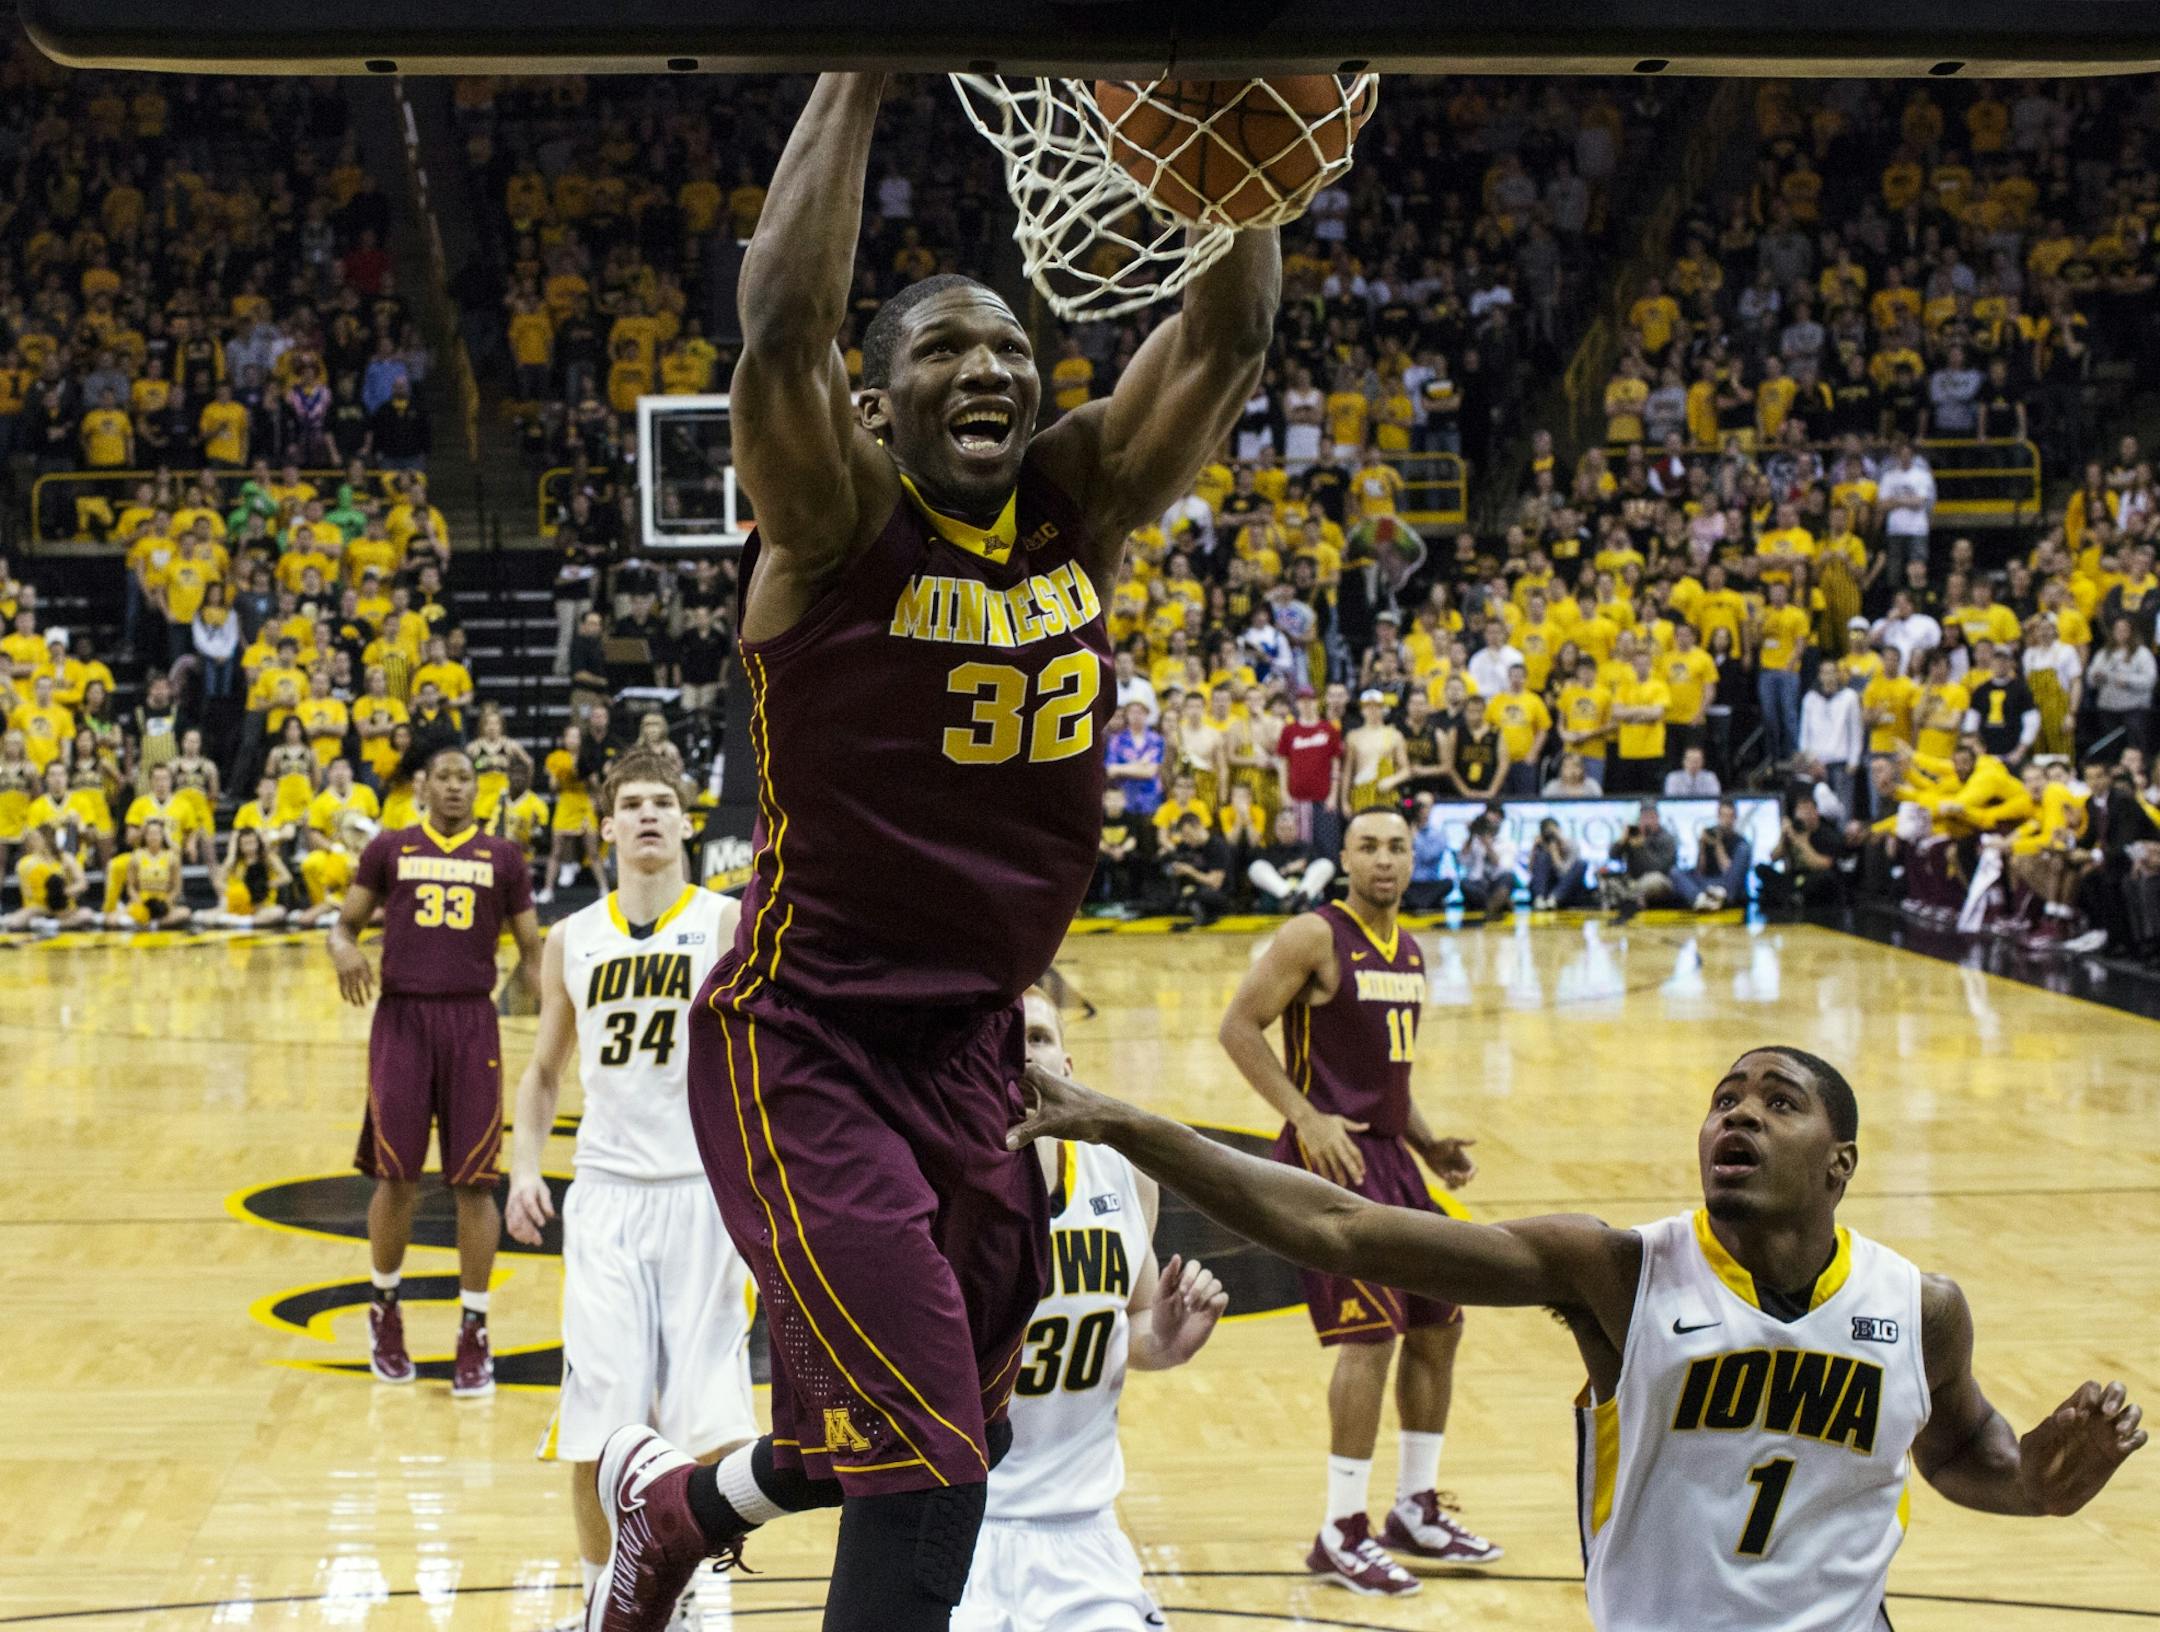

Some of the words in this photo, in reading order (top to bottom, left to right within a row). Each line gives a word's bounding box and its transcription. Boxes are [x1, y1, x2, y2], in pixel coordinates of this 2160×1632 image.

[942, 648, 1100, 764] 32
[415, 883, 476, 931] 33
[587, 952, 692, 1010] IOWA
[600, 1008, 678, 1068] 34
[1386, 1008, 1415, 1062] 11
[1013, 1308, 1117, 1397] 30
[1671, 1349, 1885, 1457] IOWA
[1734, 1455, 1797, 1559] 1
